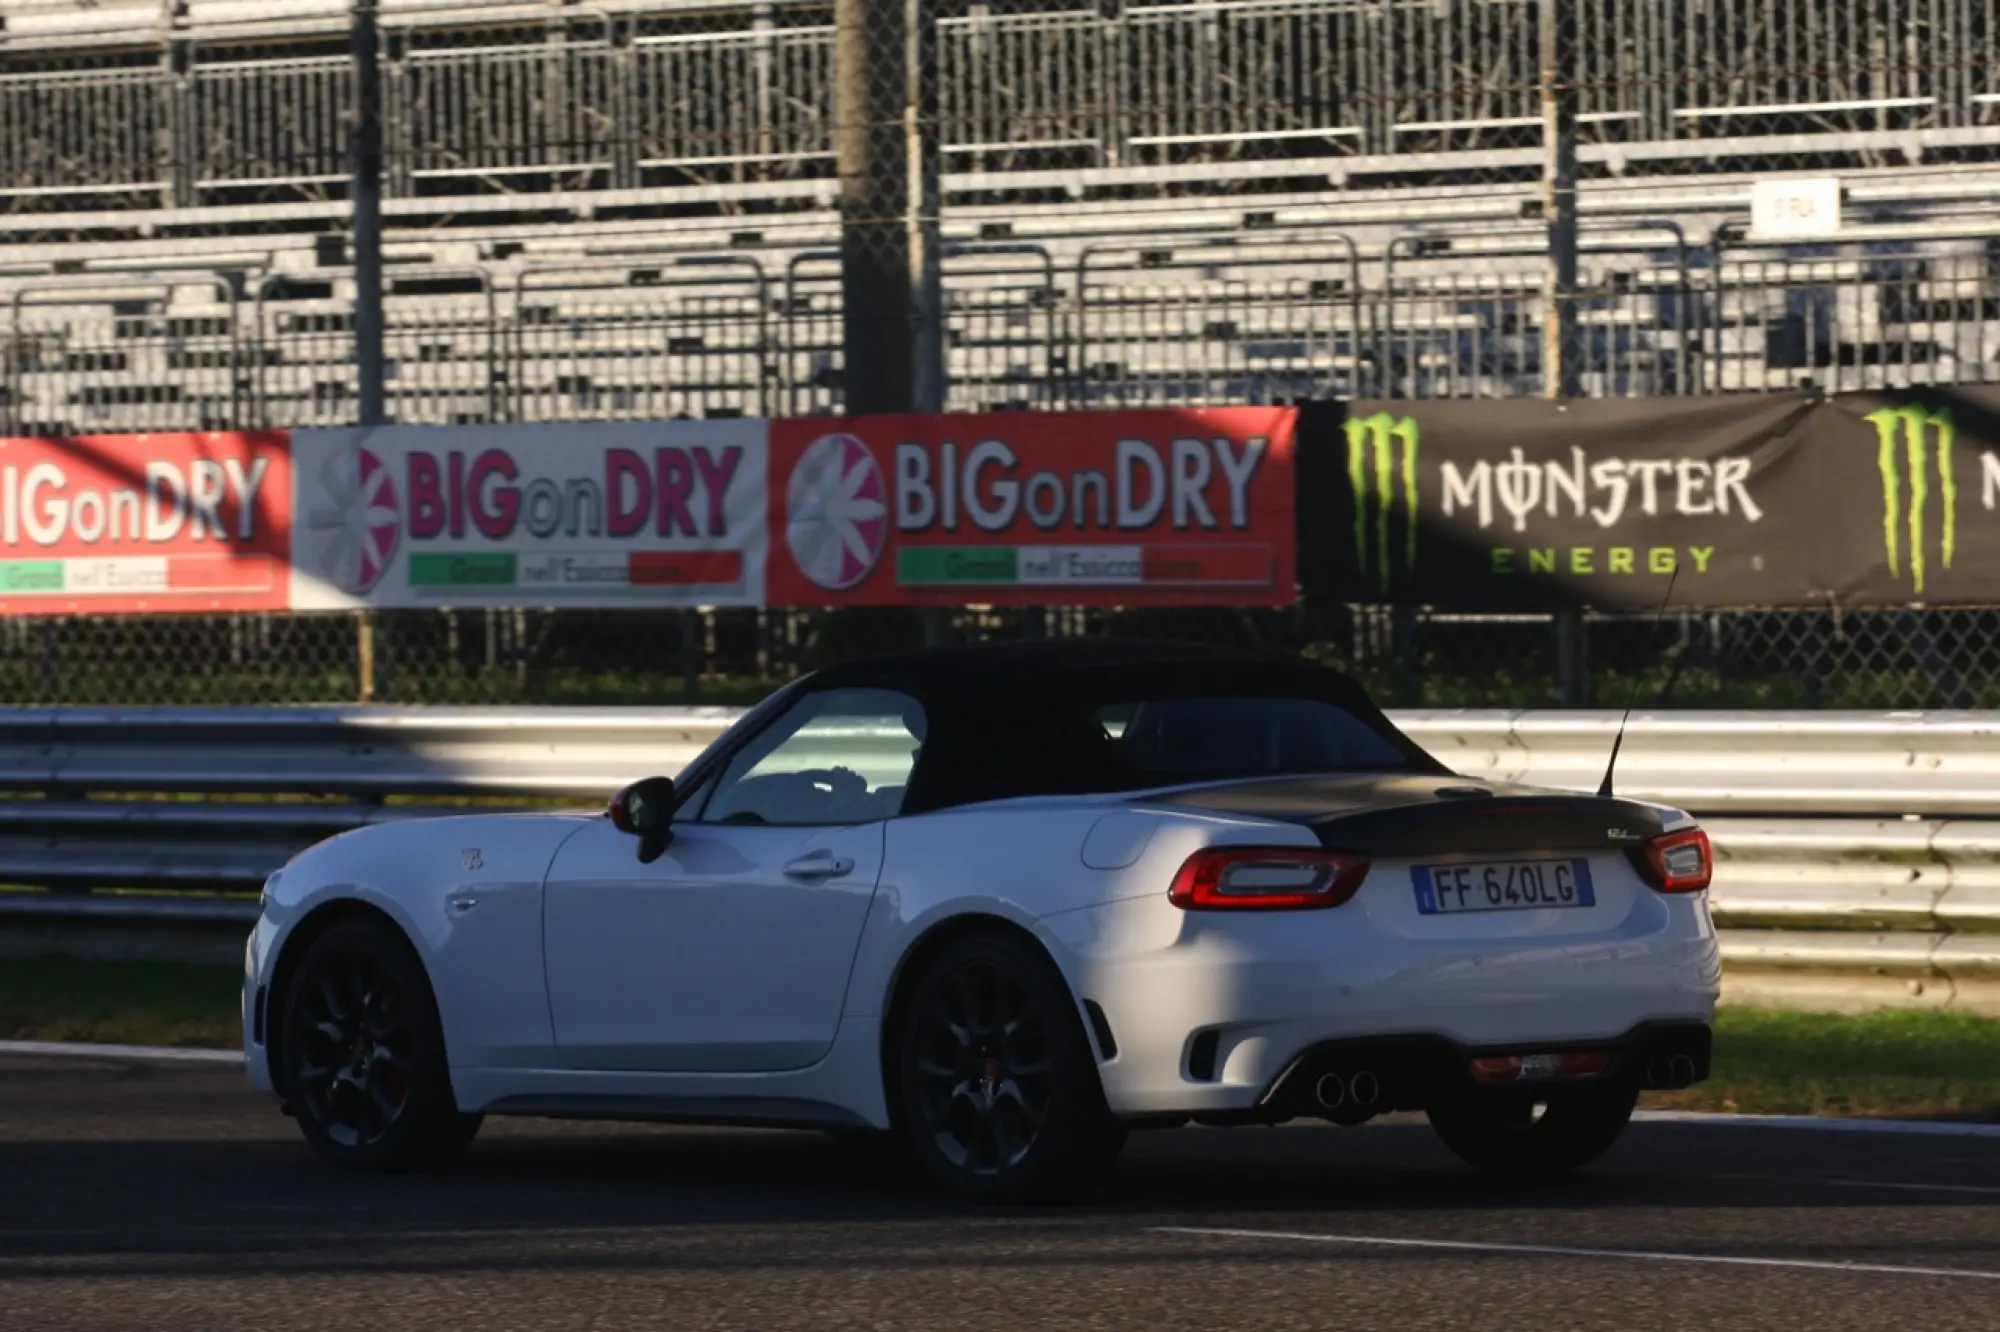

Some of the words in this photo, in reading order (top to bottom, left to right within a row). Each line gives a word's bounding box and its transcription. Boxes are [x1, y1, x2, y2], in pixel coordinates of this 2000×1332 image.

[0, 456, 270, 546] IGonDRY
[407, 446, 745, 540] BIGonDRY
[896, 436, 1268, 532] BIGonDRY
[1439, 446, 1764, 532] MONSTER
[1491, 546, 1717, 575] ENERGY
[1433, 868, 1471, 908] FF
[1483, 865, 1575, 906] 640LG
